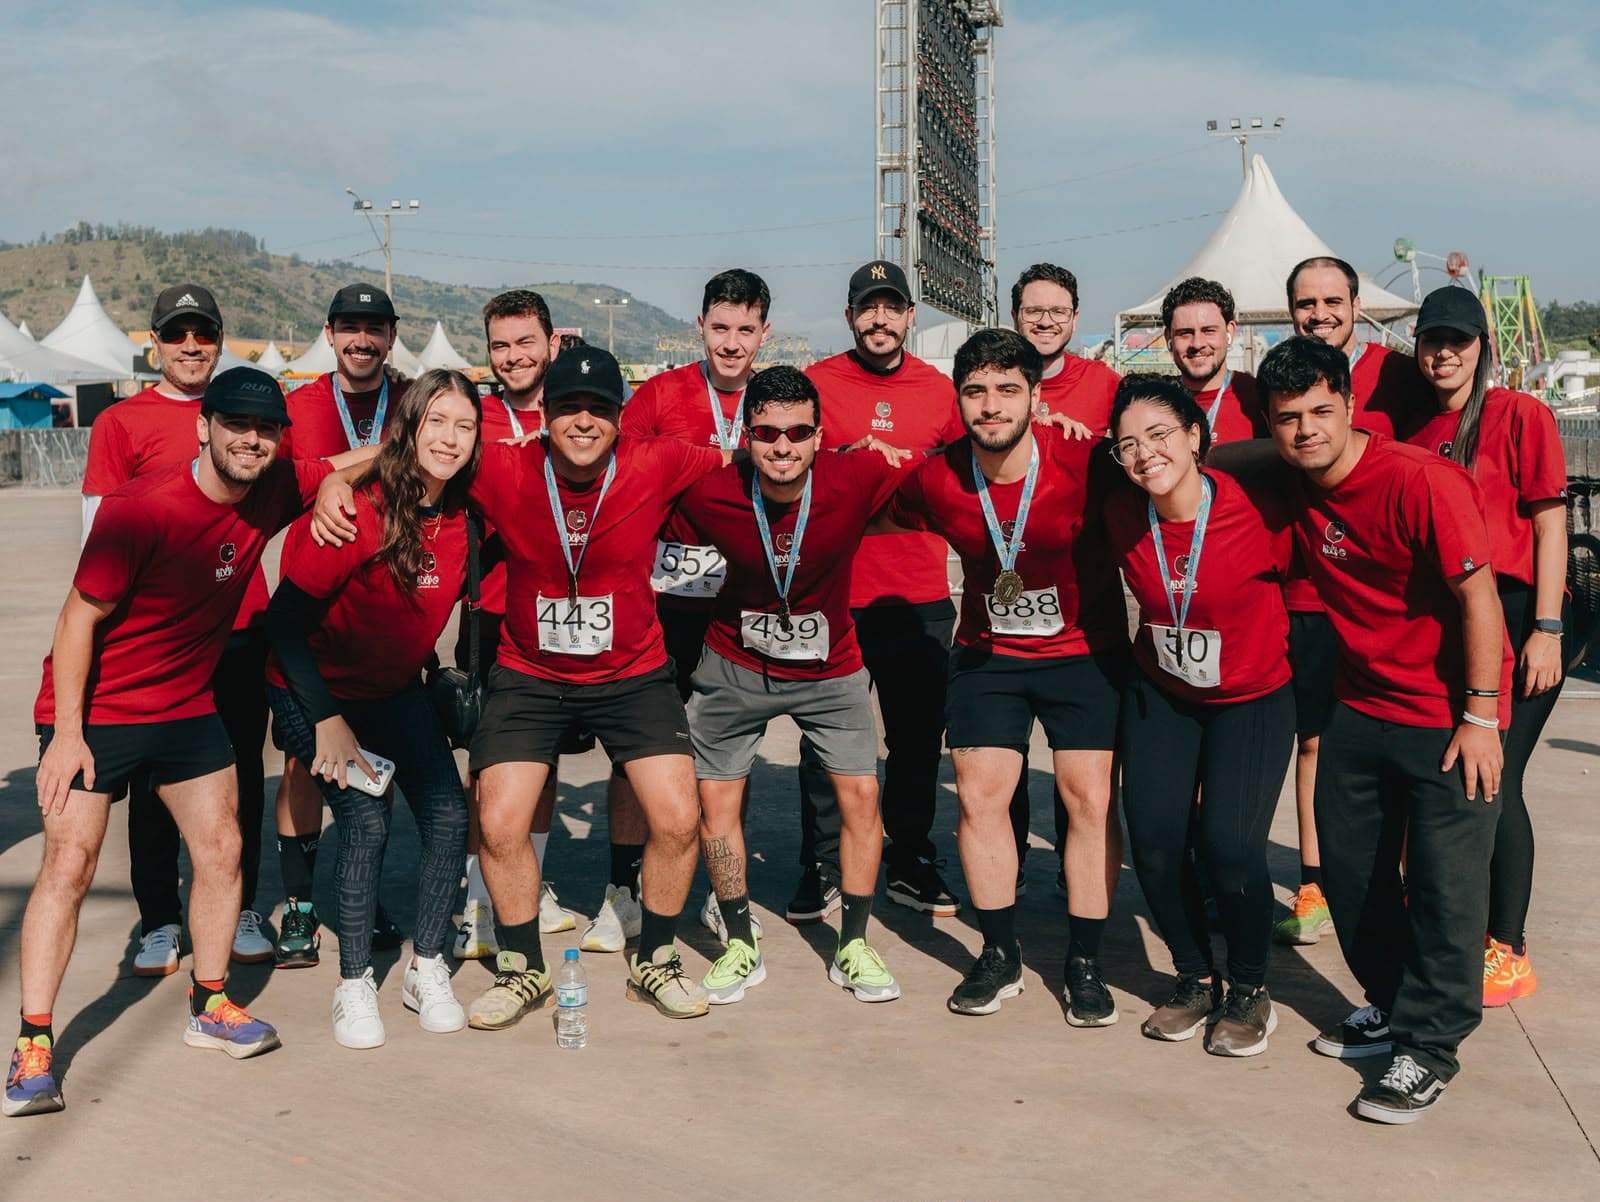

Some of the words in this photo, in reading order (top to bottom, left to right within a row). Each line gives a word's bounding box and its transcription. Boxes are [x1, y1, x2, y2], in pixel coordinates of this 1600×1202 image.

[660, 543, 722, 578] 552
[538, 601, 611, 631] 443
[988, 593, 1060, 618] 688
[750, 615, 819, 642] 439
[1165, 629, 1208, 663] 50
